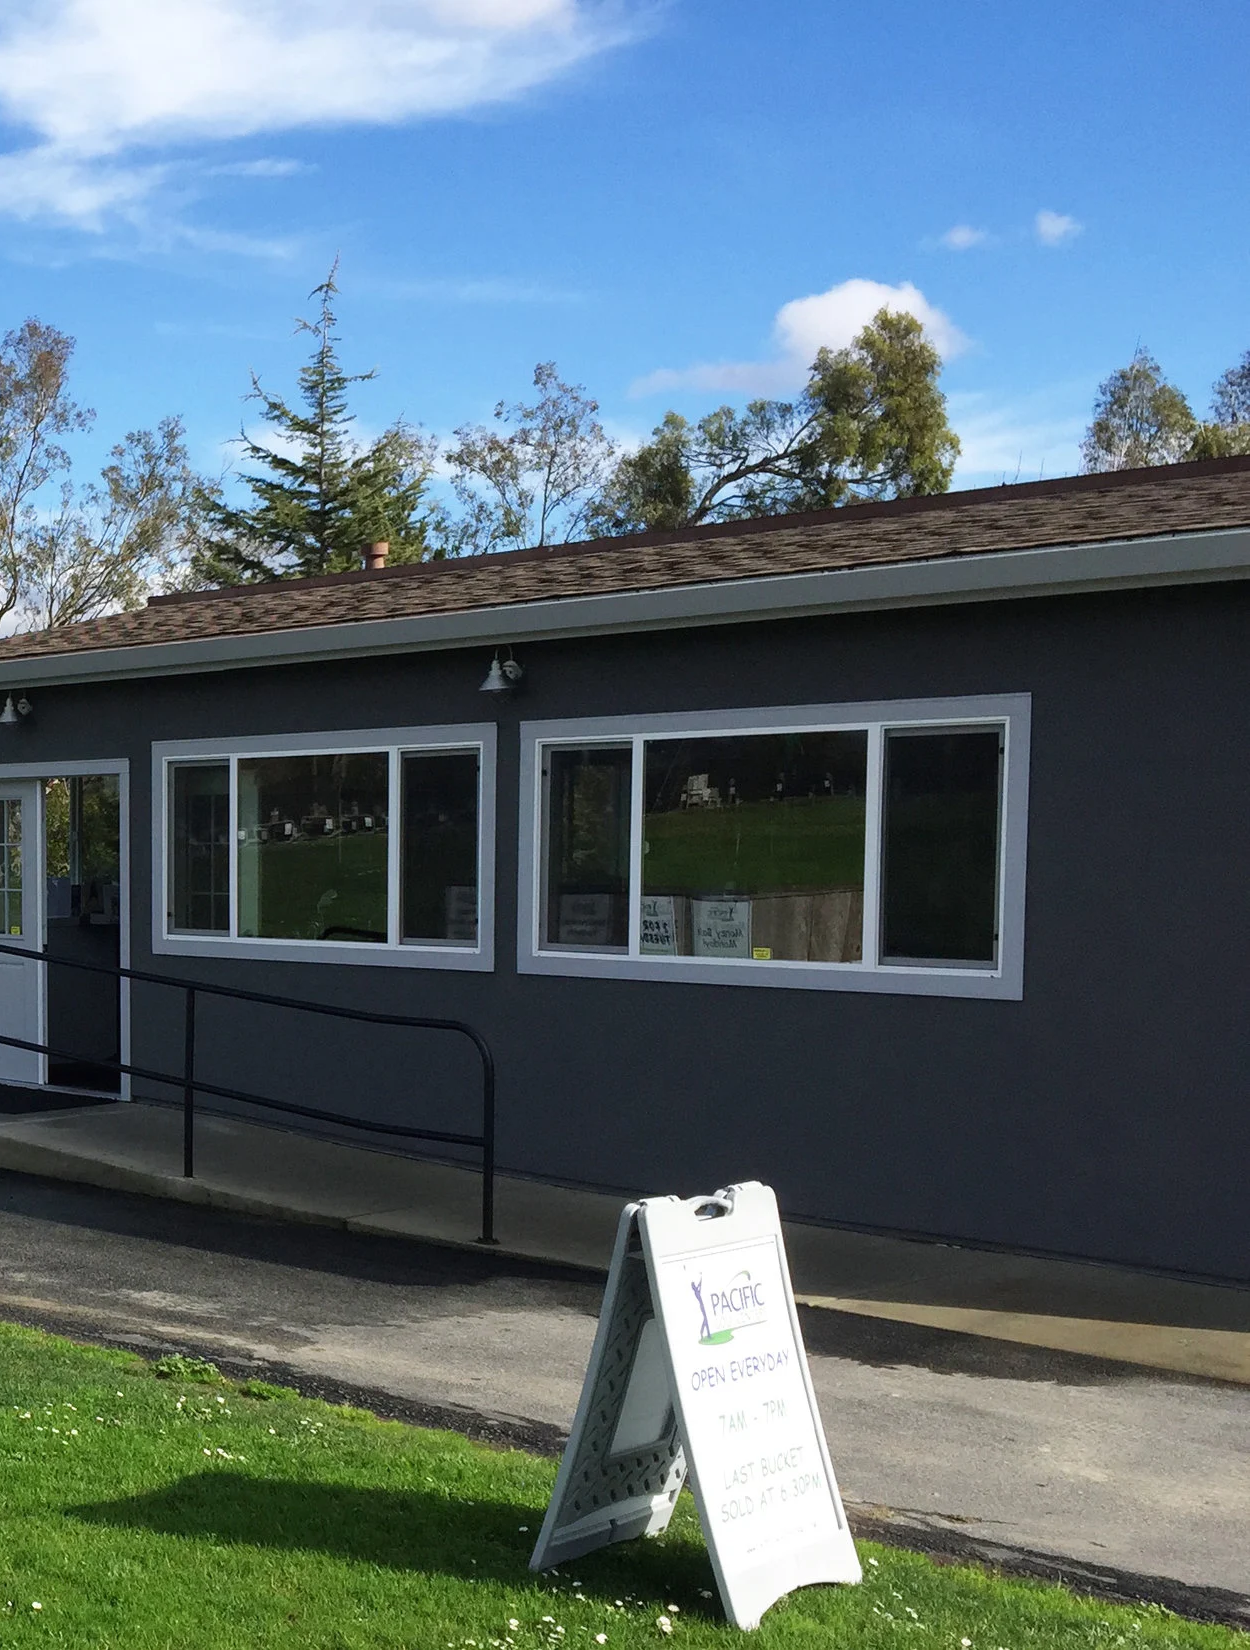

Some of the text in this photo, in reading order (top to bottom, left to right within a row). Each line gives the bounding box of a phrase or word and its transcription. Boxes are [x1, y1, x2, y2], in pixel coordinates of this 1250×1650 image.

[710, 1282, 765, 1316] PACIFIC
[691, 1348, 789, 1391] OPEN EVERYDAY
[718, 1410, 748, 1437] 7AM
[762, 1399, 787, 1424] 7PM
[723, 1446, 803, 1490] LAST BUCKET
[721, 1495, 754, 1523] SOLD
[760, 1486, 774, 1511] AT
